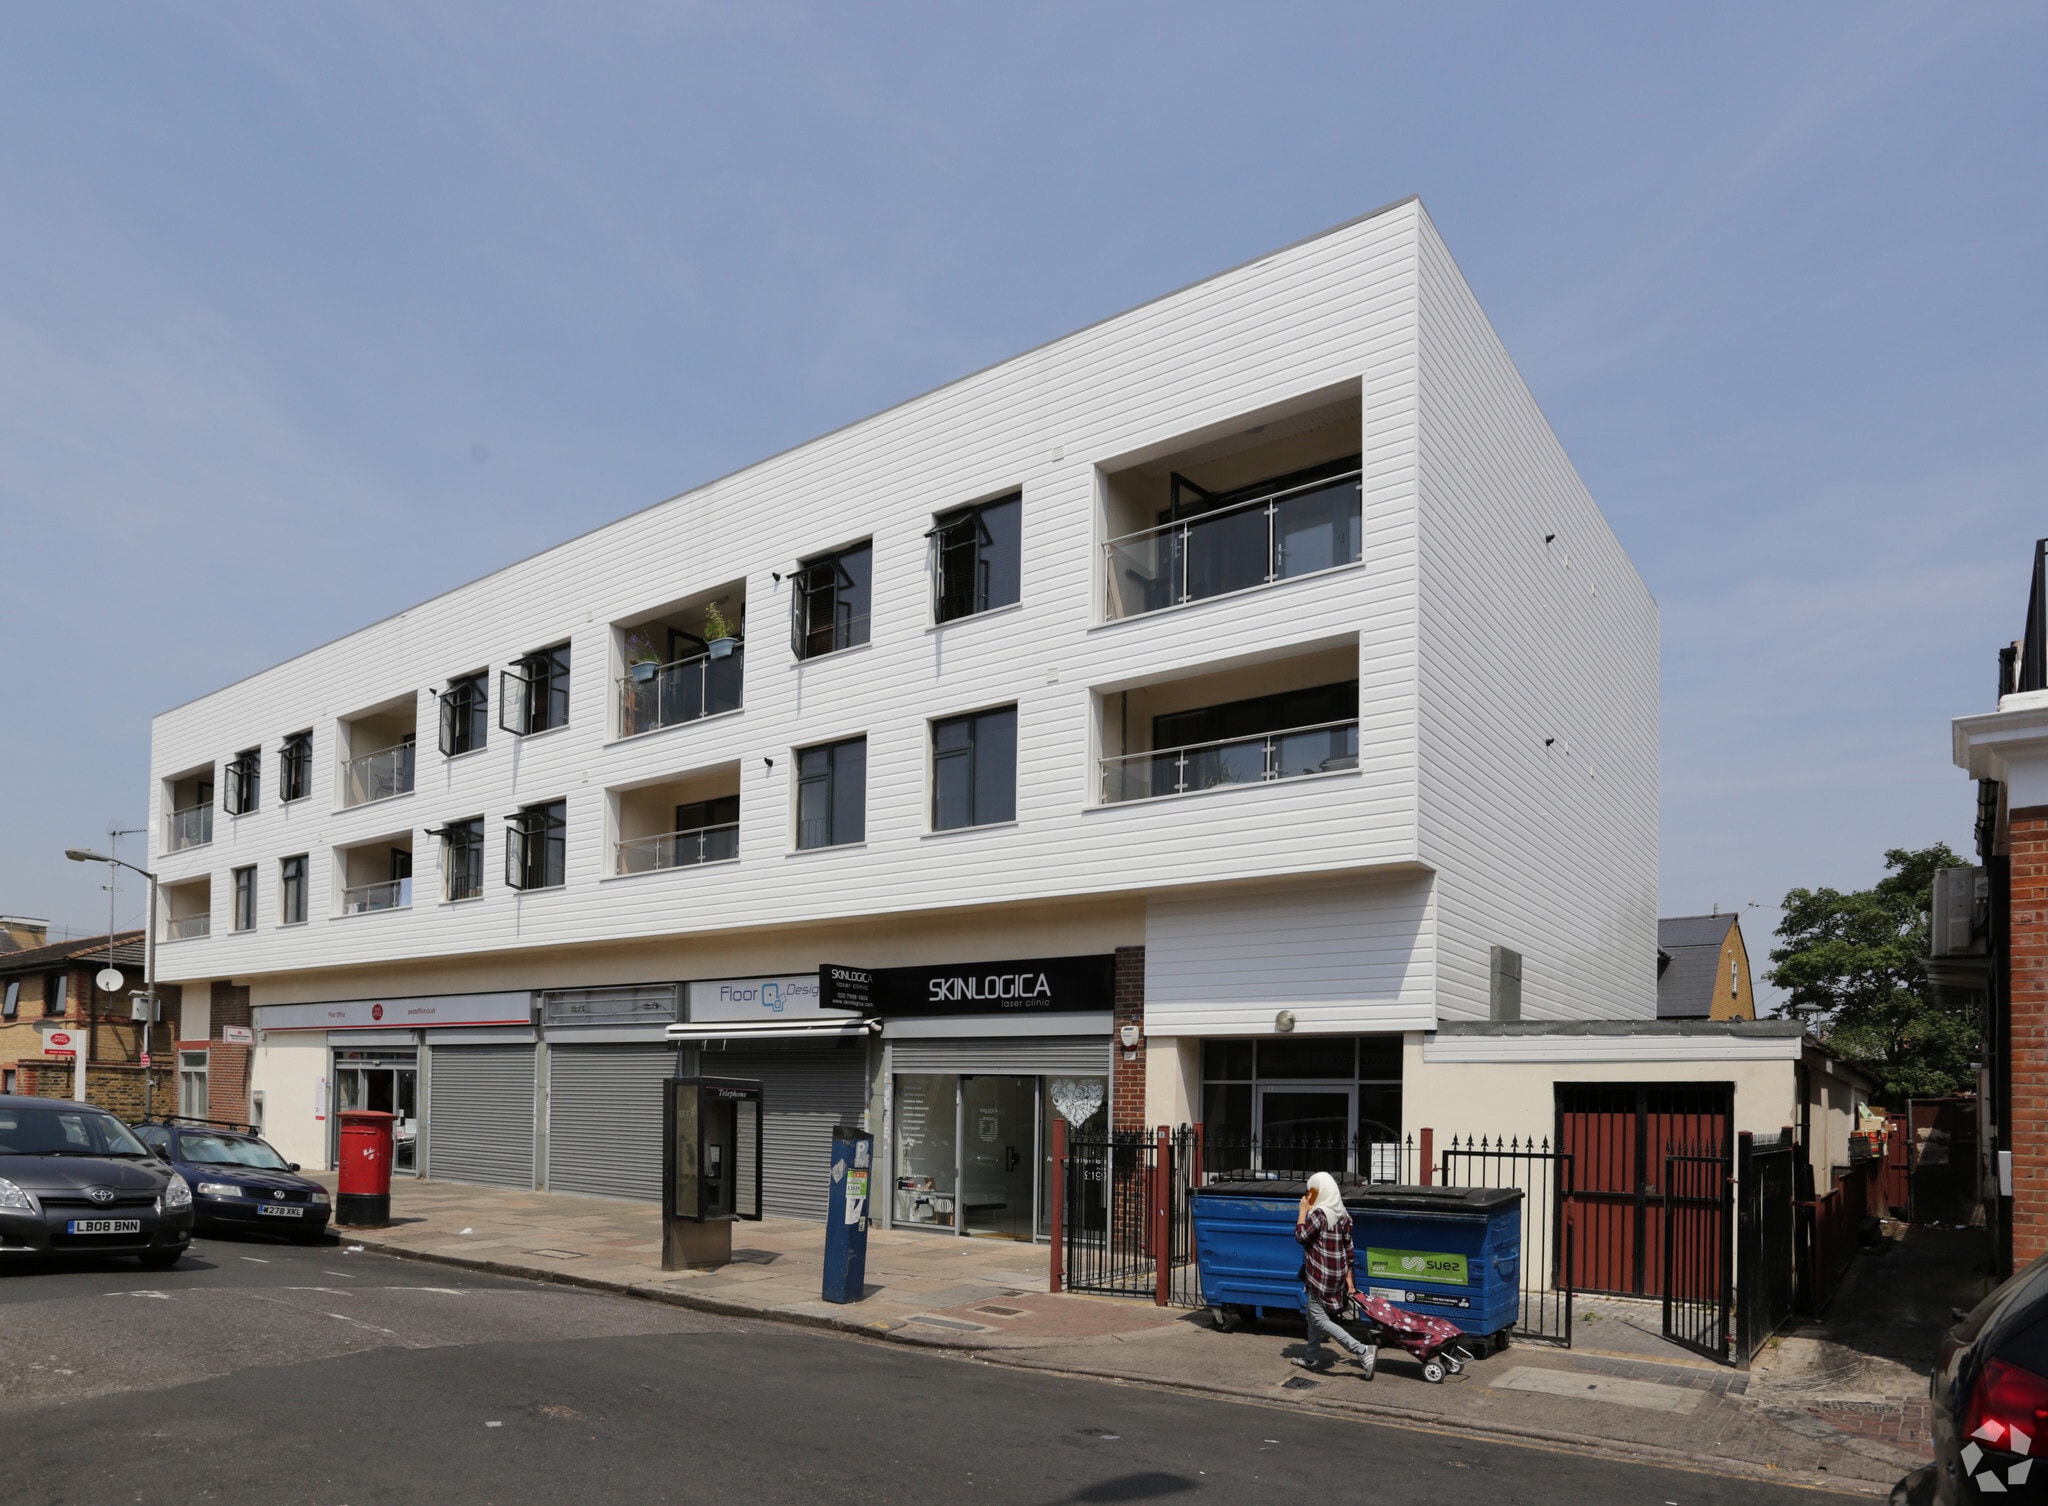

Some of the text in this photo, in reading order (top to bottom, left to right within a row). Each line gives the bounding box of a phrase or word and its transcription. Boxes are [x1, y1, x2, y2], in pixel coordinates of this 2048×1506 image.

[831, 968, 873, 983] SKINLOGICA
[720, 983, 820, 1002] Floor Desig
[853, 983, 869, 991] clinic
[929, 973, 1052, 1002] SKINLOGICA
[1025, 999, 1050, 1007] clinic
[718, 1089, 747, 1098] Telephone
[286, 1208, 301, 1216] XKL
[77, 1220, 138, 1232] LB08 BNN
[1427, 1260, 1460, 1272] suez
